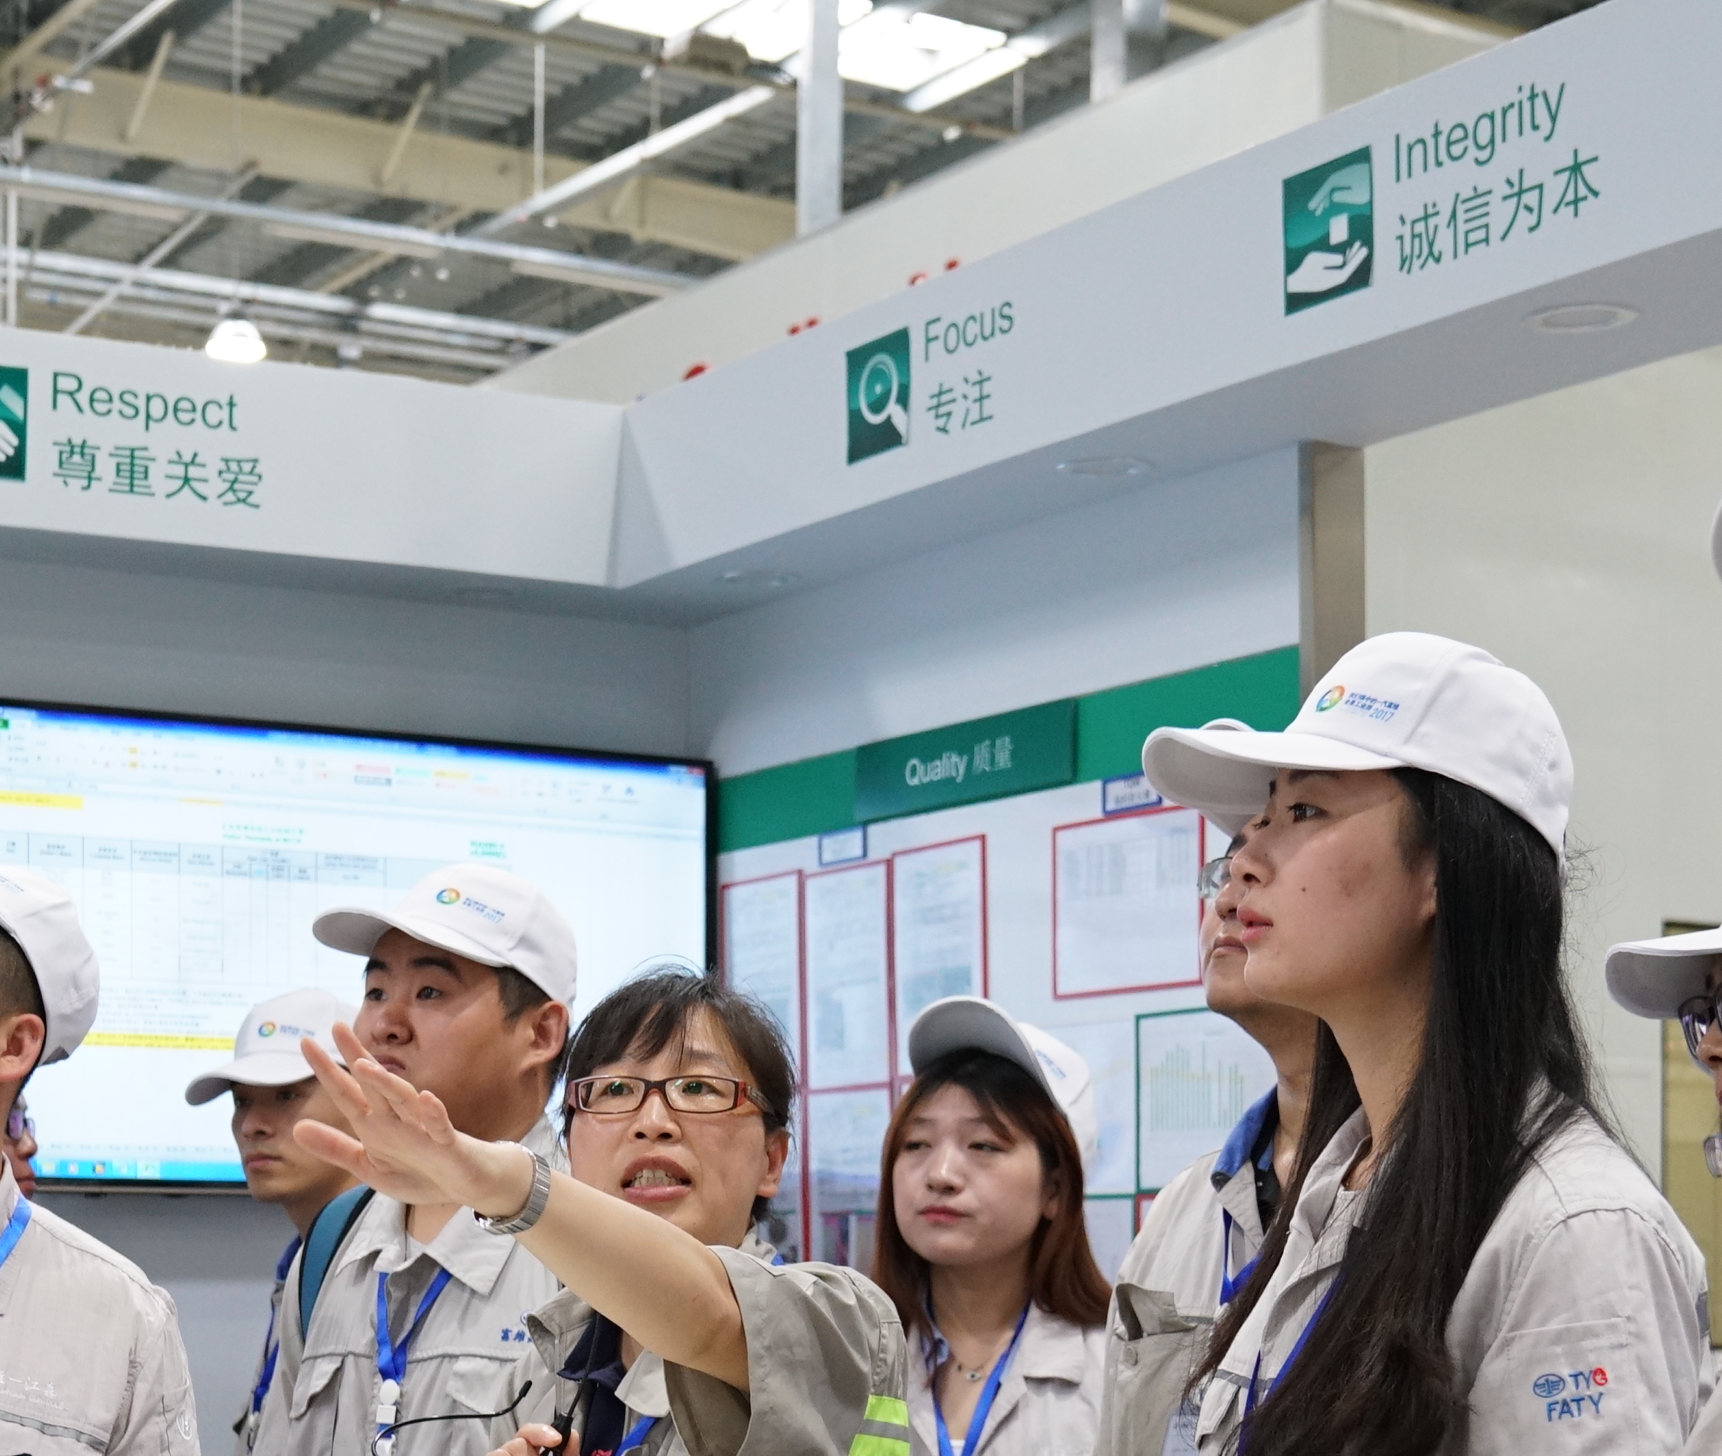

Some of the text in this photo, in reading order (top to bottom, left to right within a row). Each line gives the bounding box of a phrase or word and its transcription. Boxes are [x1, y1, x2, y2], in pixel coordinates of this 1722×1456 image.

[1394, 81, 1567, 183] Integrity
[1395, 148, 1600, 275] 诚信为本
[924, 300, 1015, 362] Focus
[52, 371, 239, 432] Respect
[926, 369, 994, 436] 专注
[52, 437, 263, 510] 尊重关爱
[1369, 708, 1395, 722] 2017
[905, 737, 1012, 788] Quality 质量
[1546, 1392, 1604, 1422] FATY
